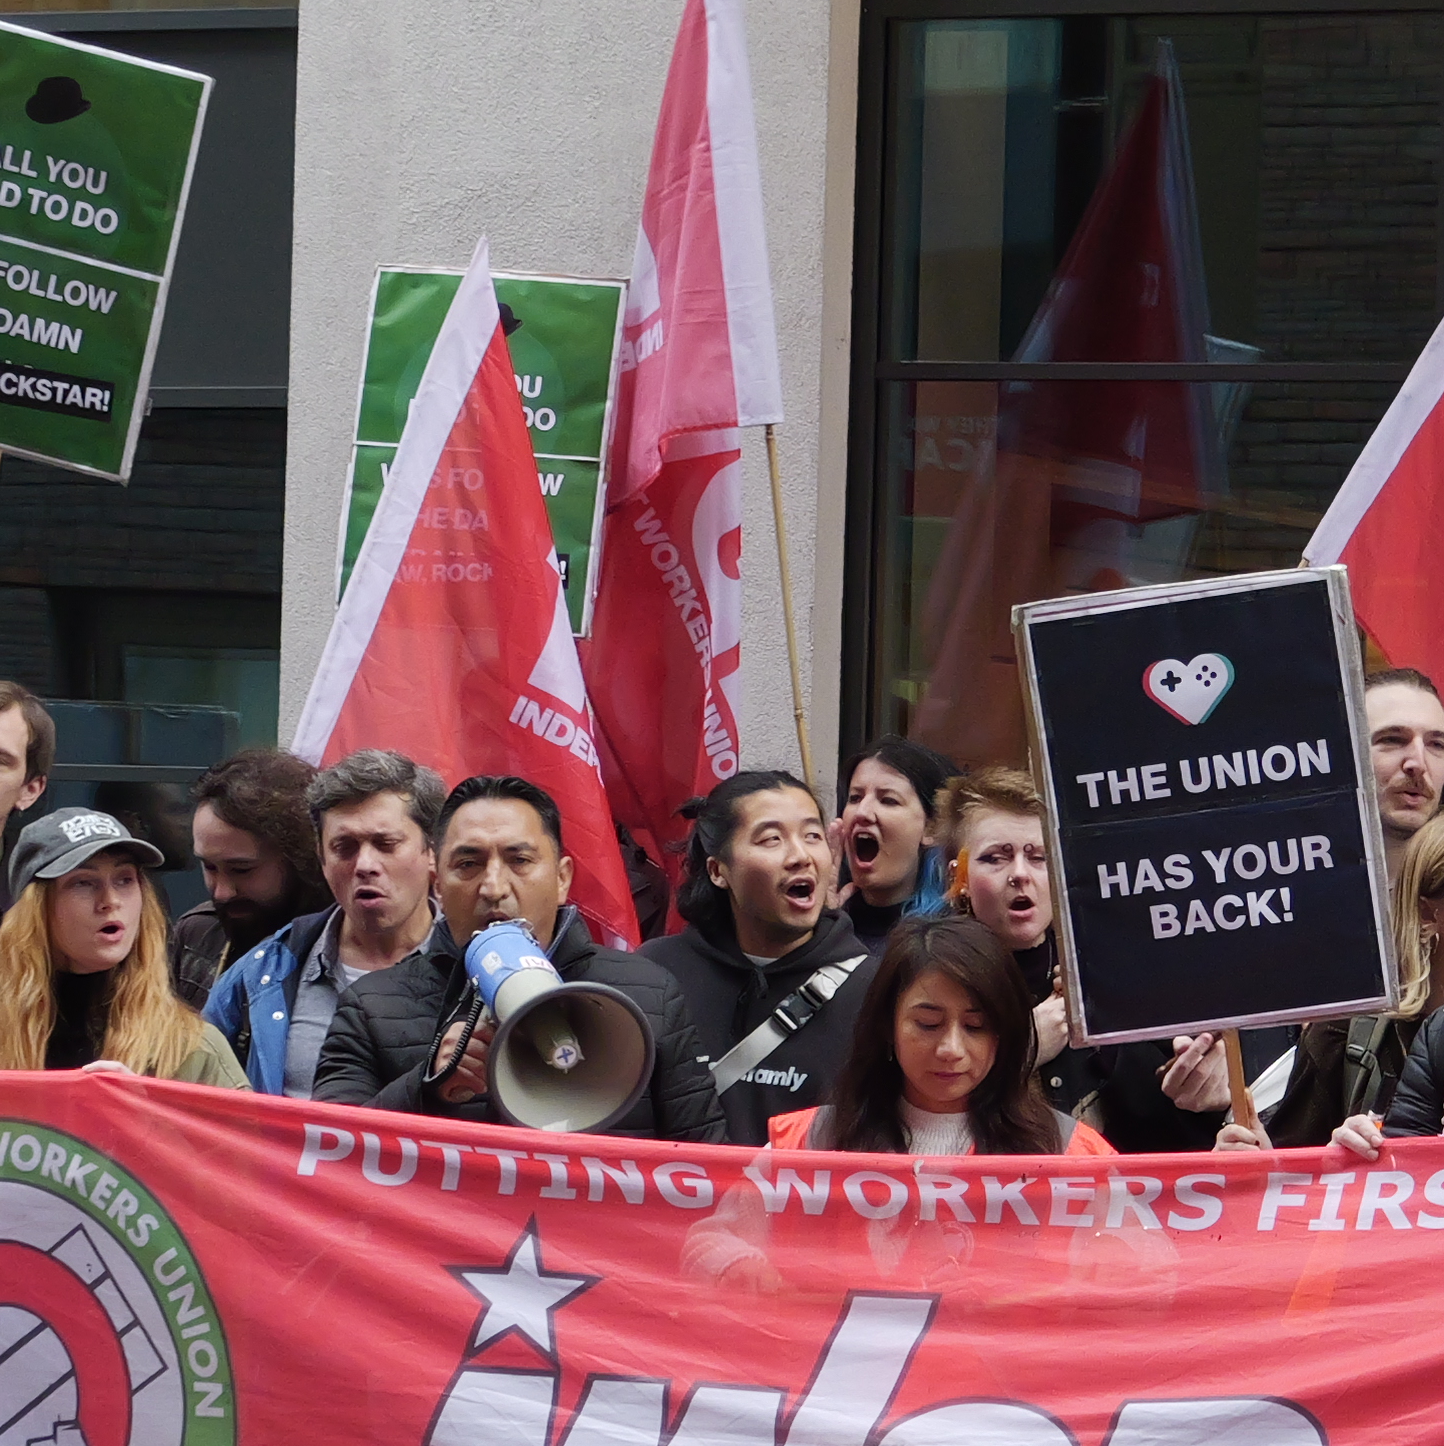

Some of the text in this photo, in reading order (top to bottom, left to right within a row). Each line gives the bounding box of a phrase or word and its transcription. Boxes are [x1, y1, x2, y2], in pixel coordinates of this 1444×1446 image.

[46, 155, 107, 195] YOU
[27, 187, 69, 221] TO
[71, 201, 119, 235] DO
[1076, 739, 1332, 808] THE UNION
[1097, 834, 1334, 898] HAS YOUR
[1149, 887, 1295, 940] BACK!
[296, 1122, 715, 1209] PUTTING
[743, 1166, 1226, 1232] WORKERS
[152, 1247, 227, 1419] UNION
